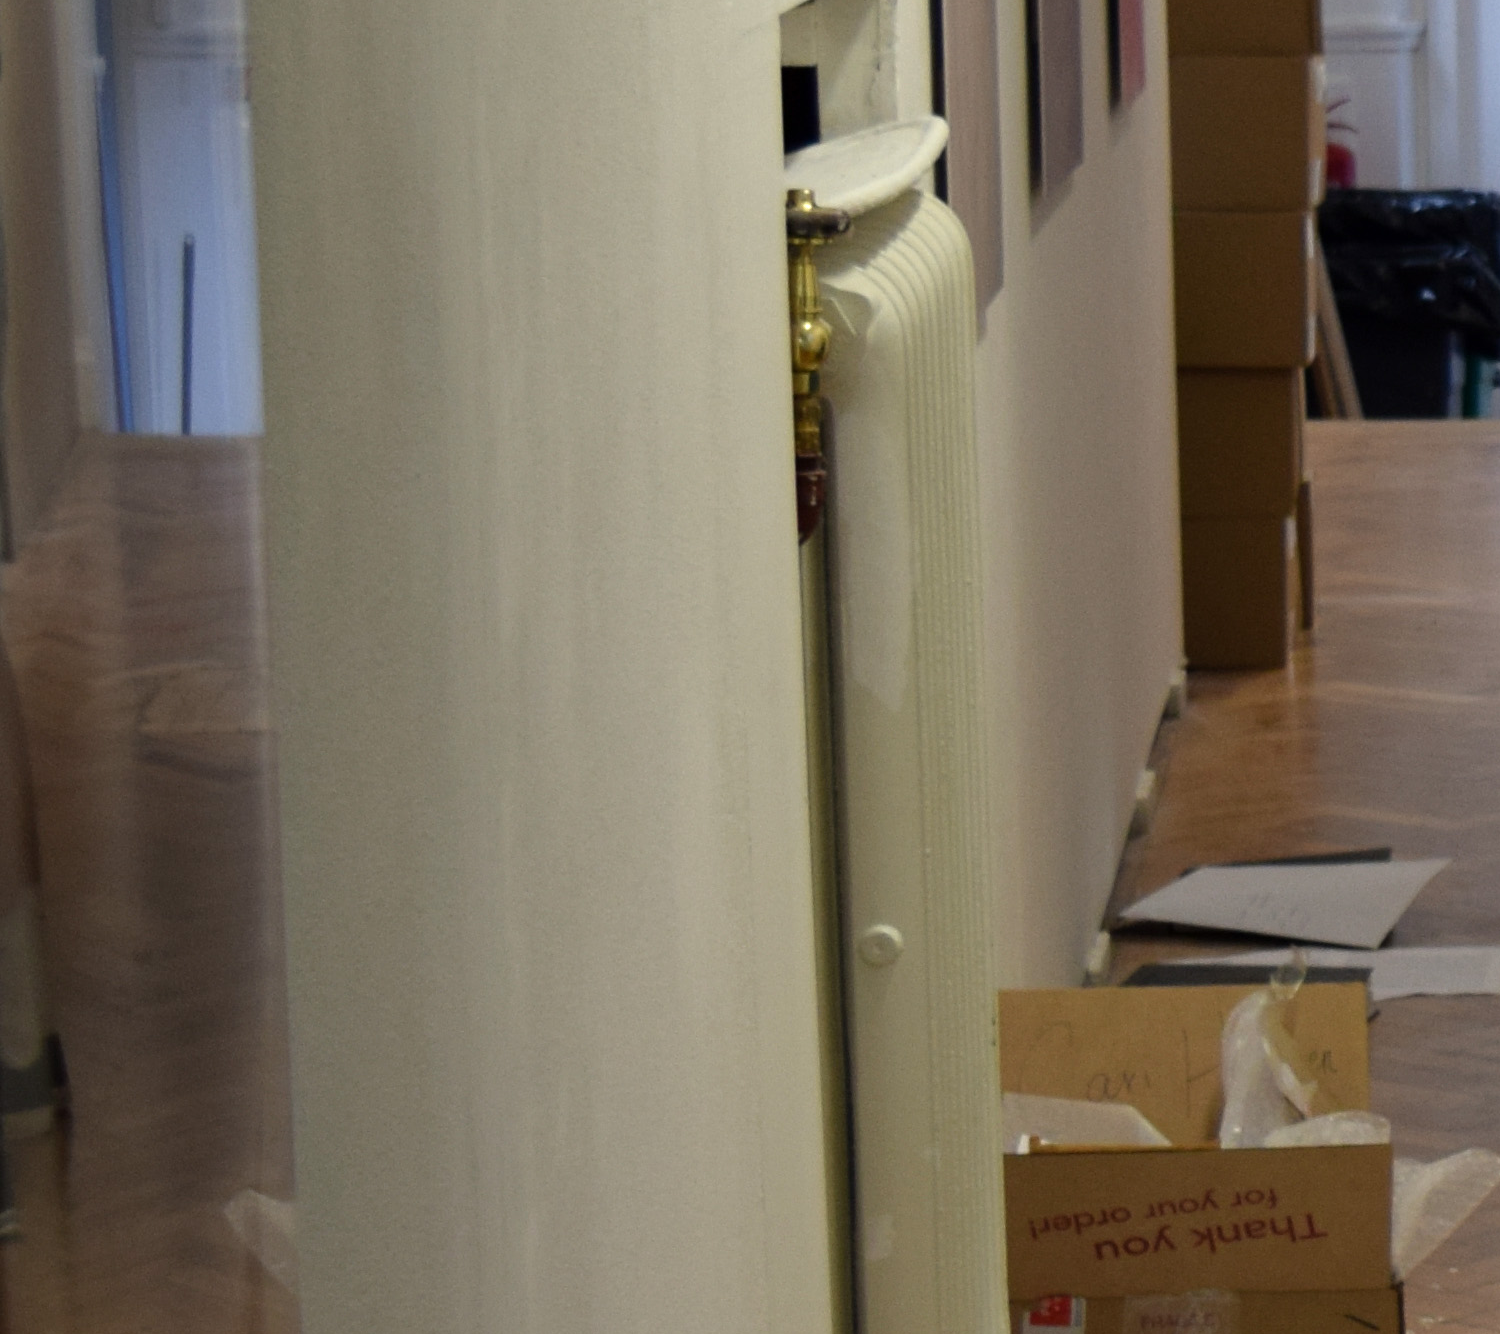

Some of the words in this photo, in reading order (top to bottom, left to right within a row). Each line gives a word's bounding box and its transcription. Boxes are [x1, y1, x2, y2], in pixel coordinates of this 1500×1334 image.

[1146, 1187, 1220, 1219] your
[1231, 1187, 1277, 1210] for
[1028, 1207, 1132, 1241] order!
[1190, 1212, 1329, 1254] Thank
[1094, 1225, 1176, 1261] you
